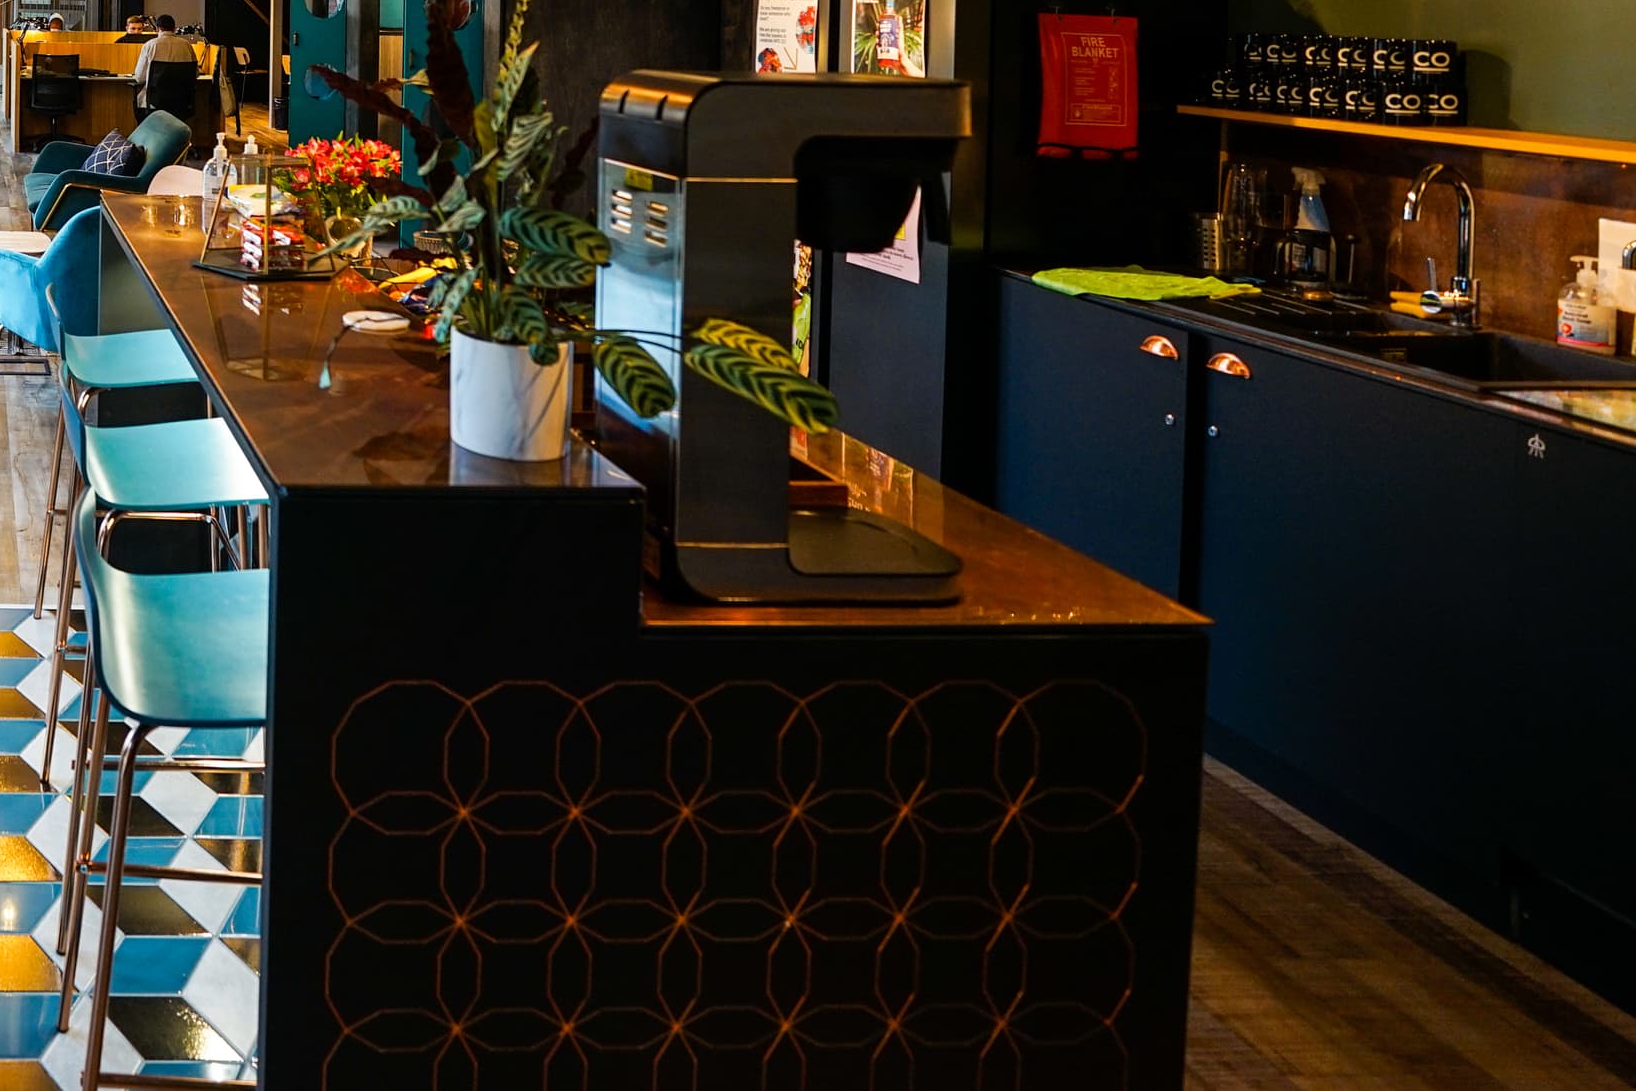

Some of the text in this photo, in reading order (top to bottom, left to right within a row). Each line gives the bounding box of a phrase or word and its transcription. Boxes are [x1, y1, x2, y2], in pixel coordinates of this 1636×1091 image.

[1080, 36, 1106, 47] FIRE
[1071, 46, 1119, 59] BLANKET
[1413, 51, 1450, 67] CO
[1385, 94, 1421, 109] CO
